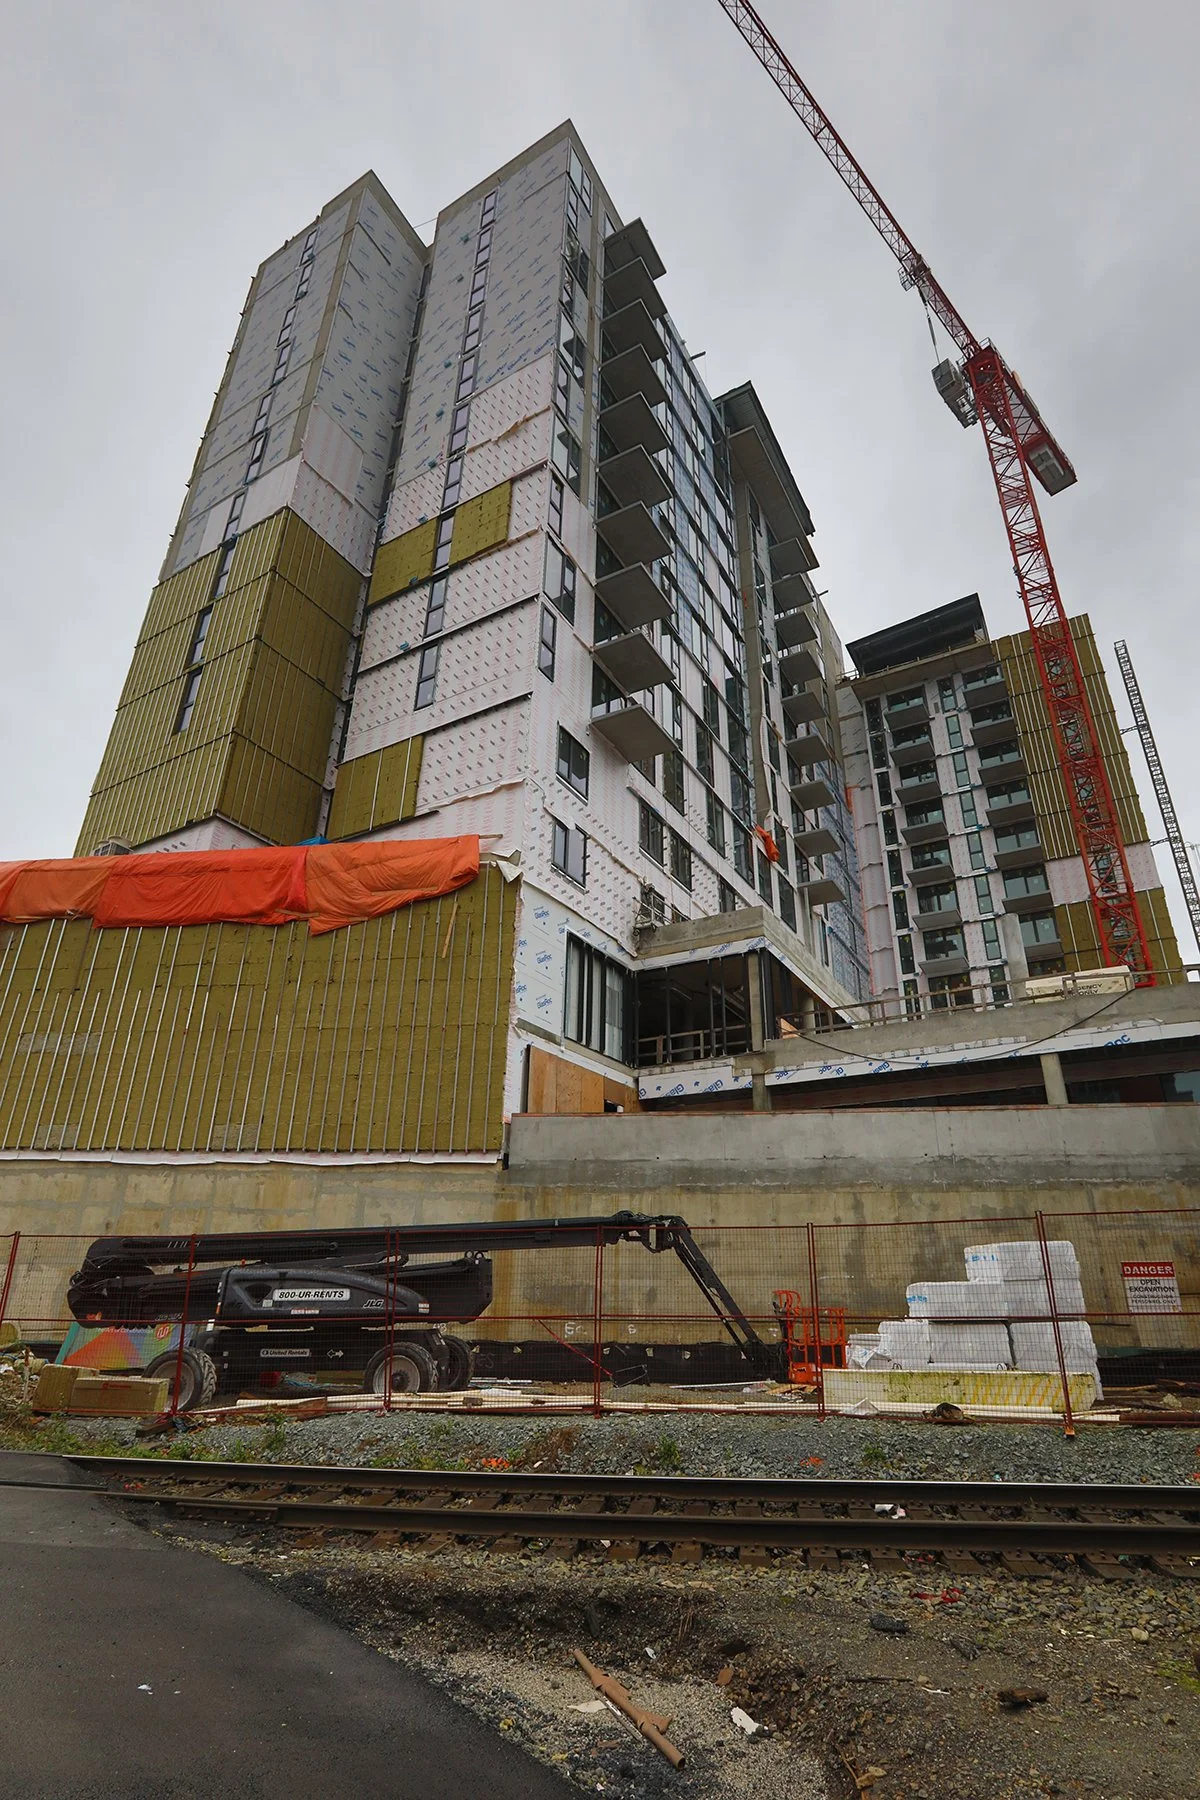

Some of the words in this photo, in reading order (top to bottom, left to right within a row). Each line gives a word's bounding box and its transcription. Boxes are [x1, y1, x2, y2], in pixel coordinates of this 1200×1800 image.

[1123, 1266, 1173, 1274] DANGER
[1140, 1278, 1160, 1286] OPEN
[1129, 1285, 1174, 1293] EXCAVATION
[278, 1290, 345, 1299] 800-UR-RENTS
[362, 1299, 385, 1309] JLG
